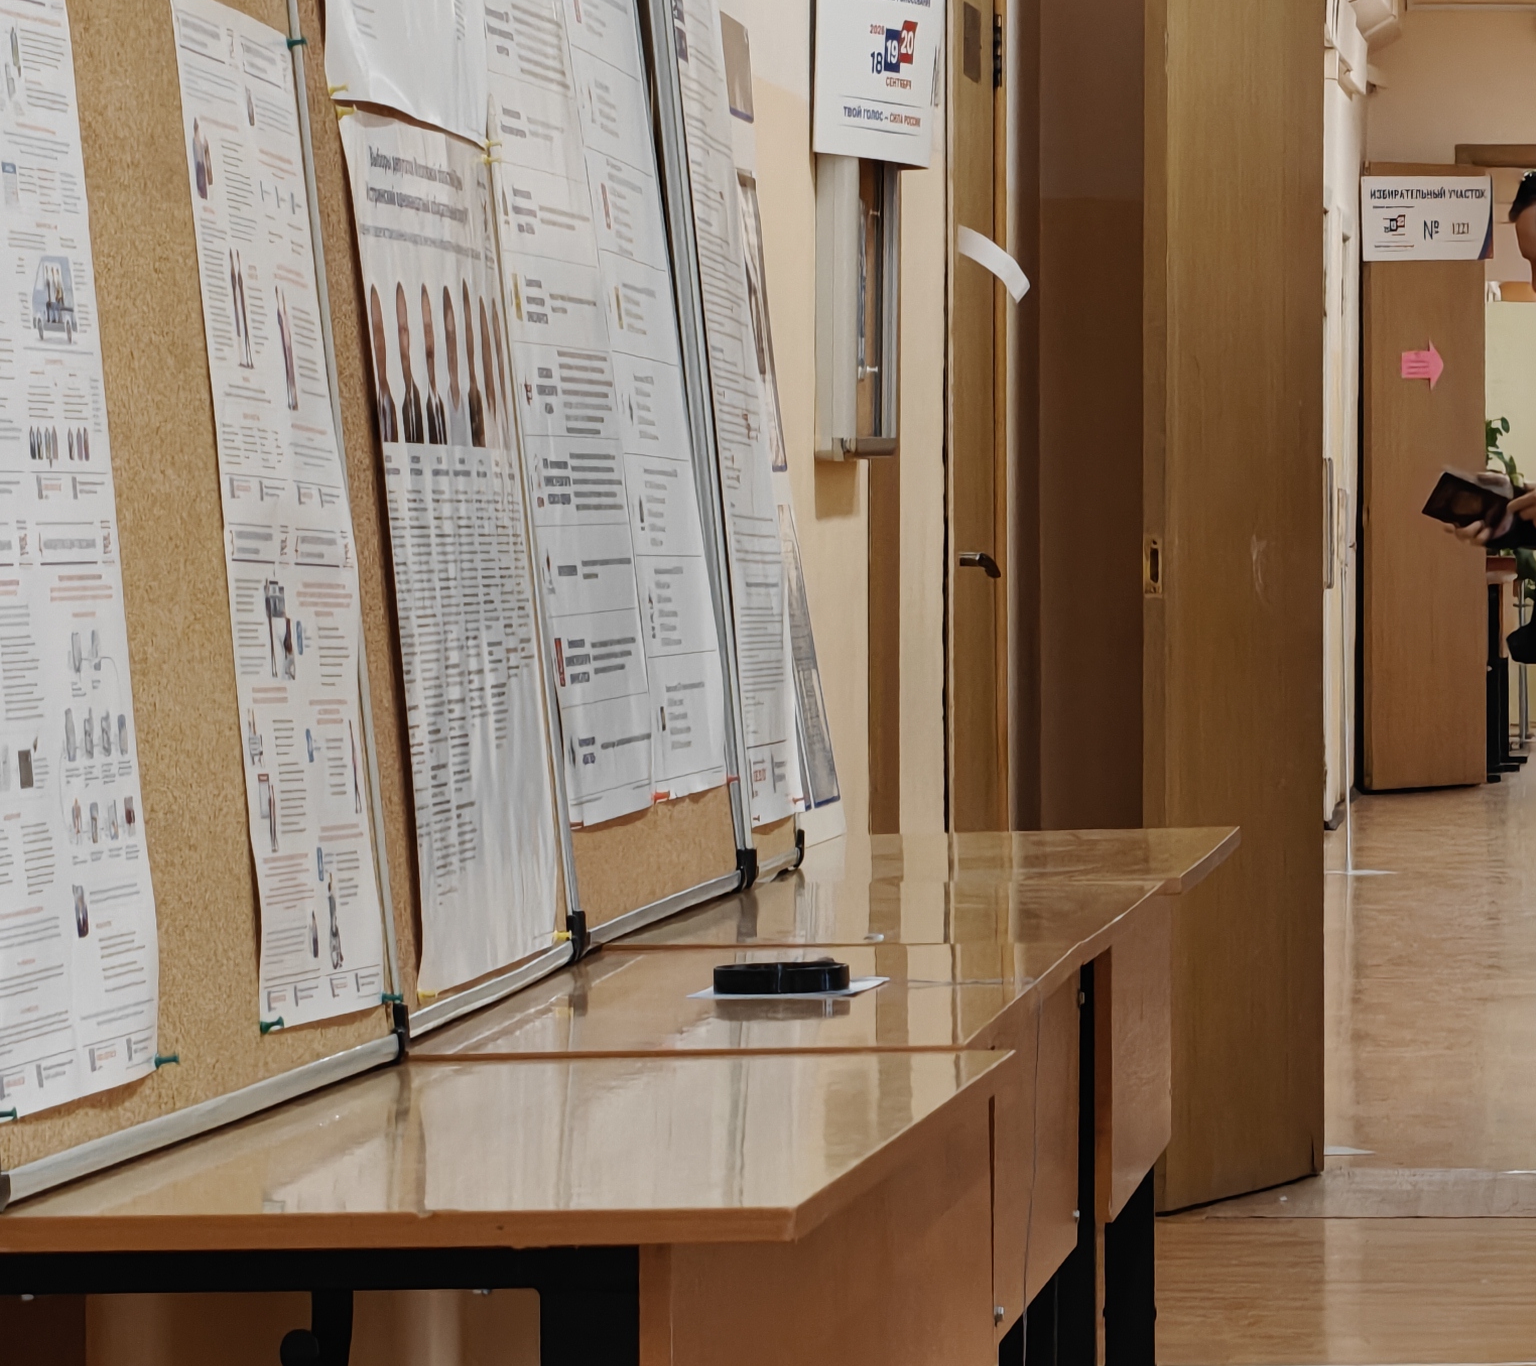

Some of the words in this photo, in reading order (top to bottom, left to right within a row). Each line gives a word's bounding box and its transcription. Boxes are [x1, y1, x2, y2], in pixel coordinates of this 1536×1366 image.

[870, 51, 883, 75] 18
[886, 39, 898, 64] 19
[901, 30, 914, 55] 20
[843, 106, 862, 120] ТВОЙ
[863, 108, 883, 122] ГОЛОС
[1370, 186, 1446, 200] ИЗБИРАТЕЛЬНЫЙ
[1448, 188, 1487, 199] УЧАСТОК
[1423, 219, 1440, 240] №
